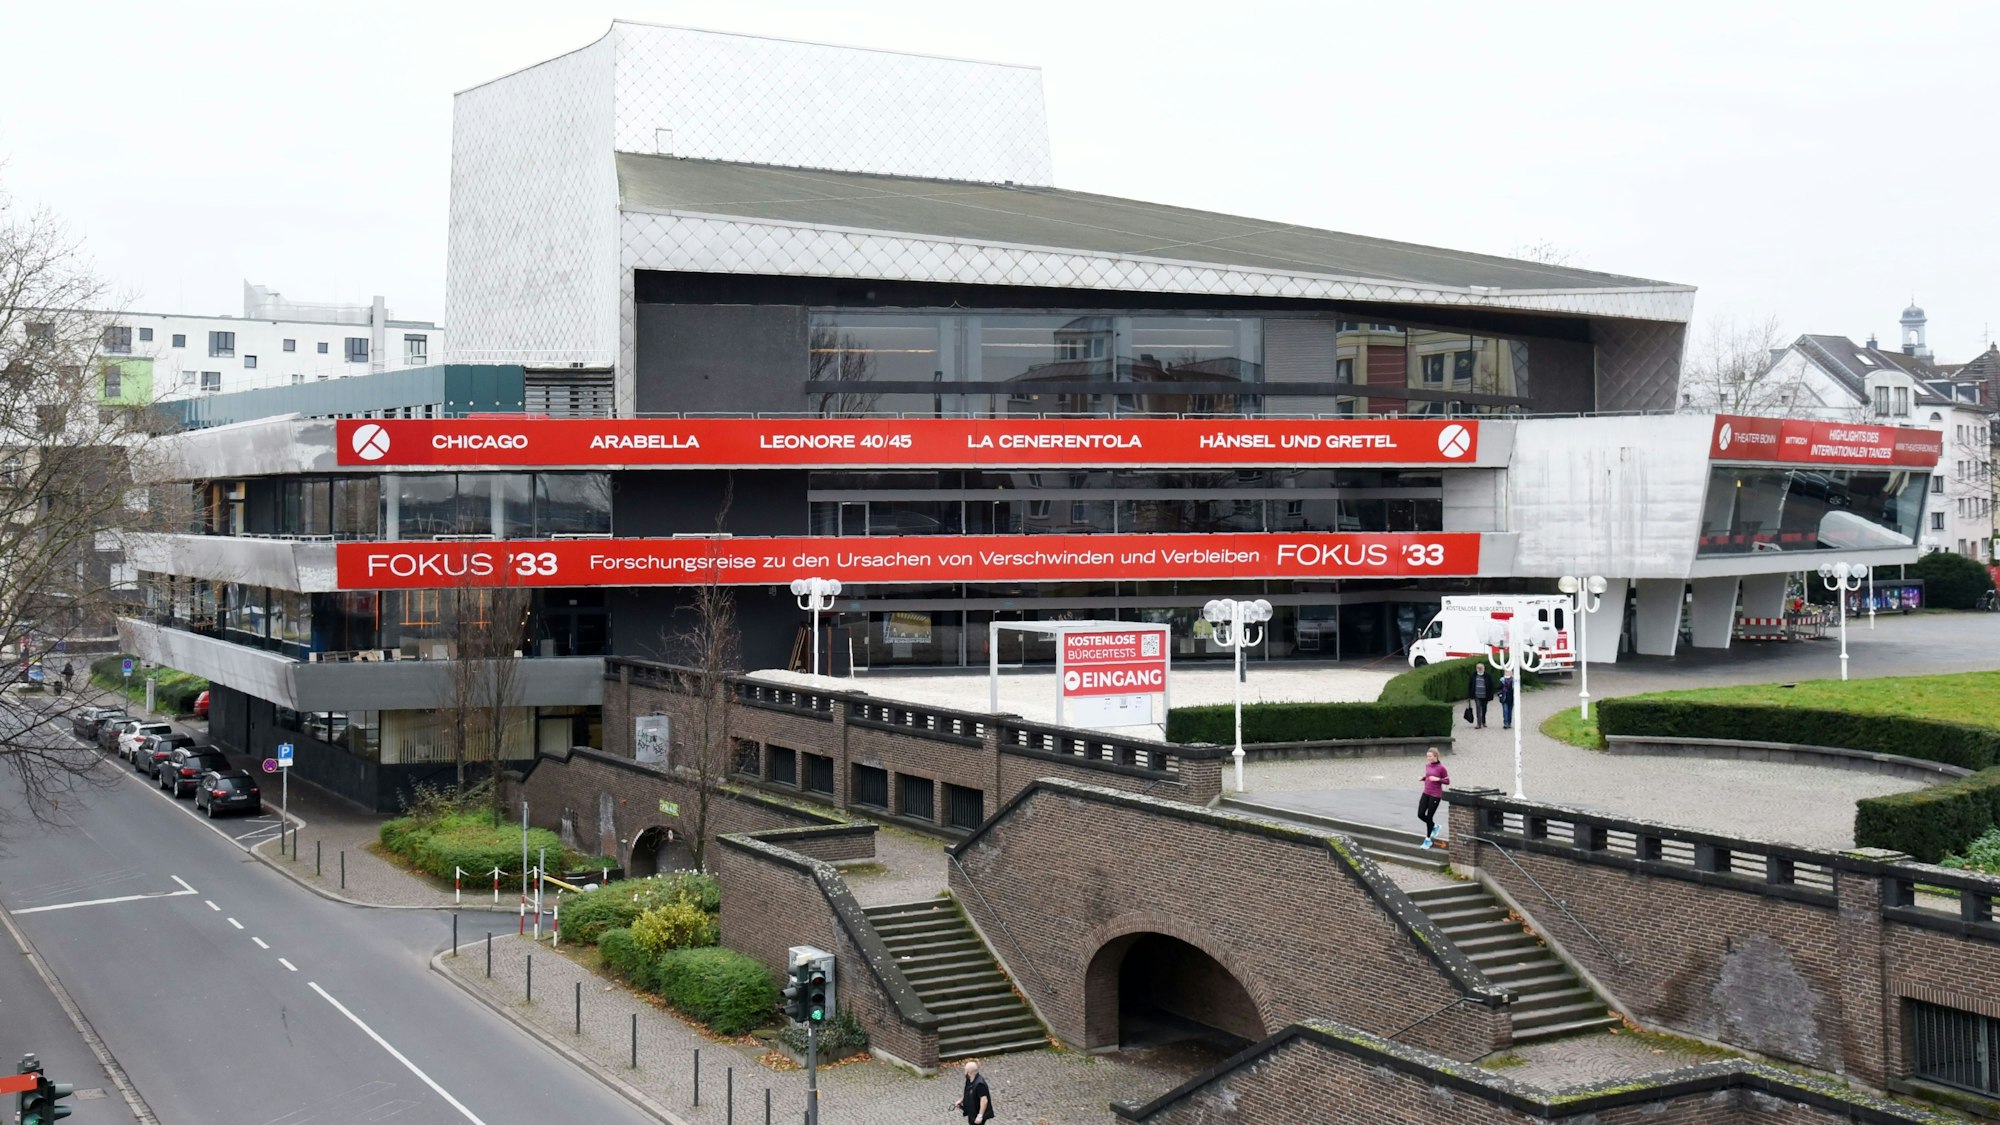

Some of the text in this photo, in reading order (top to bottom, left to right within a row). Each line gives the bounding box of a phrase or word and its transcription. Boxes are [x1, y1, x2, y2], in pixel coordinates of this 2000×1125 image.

[432, 434, 529, 450] CHICAGO
[590, 434, 700, 450] ARABELLA
[760, 433, 913, 450] LEONORE 40/45
[967, 434, 1143, 449] LA CENERENTOLA
[1199, 431, 1398, 449] HÄNSEL UND GRETEL
[1734, 432, 1777, 445] THEATER BONN
[1829, 429, 1880, 444] HIGHLIGHTS DES
[1810, 443, 1893, 460] INTERNATIONALEN TANZES
[590, 548, 1260, 572] Forschungsreise zu den Ursachen von Verschwinden und Verbleiben
[1277, 544, 1388, 567] FOKUS
[368, 553, 494, 577] FOKUS
[1067, 635, 1136, 646] KOSTENLOSE
[1067, 648, 1136, 660] BÜRGERTESTS
[1082, 669, 1162, 688] EINGANG
[281, 746, 290, 758] P
